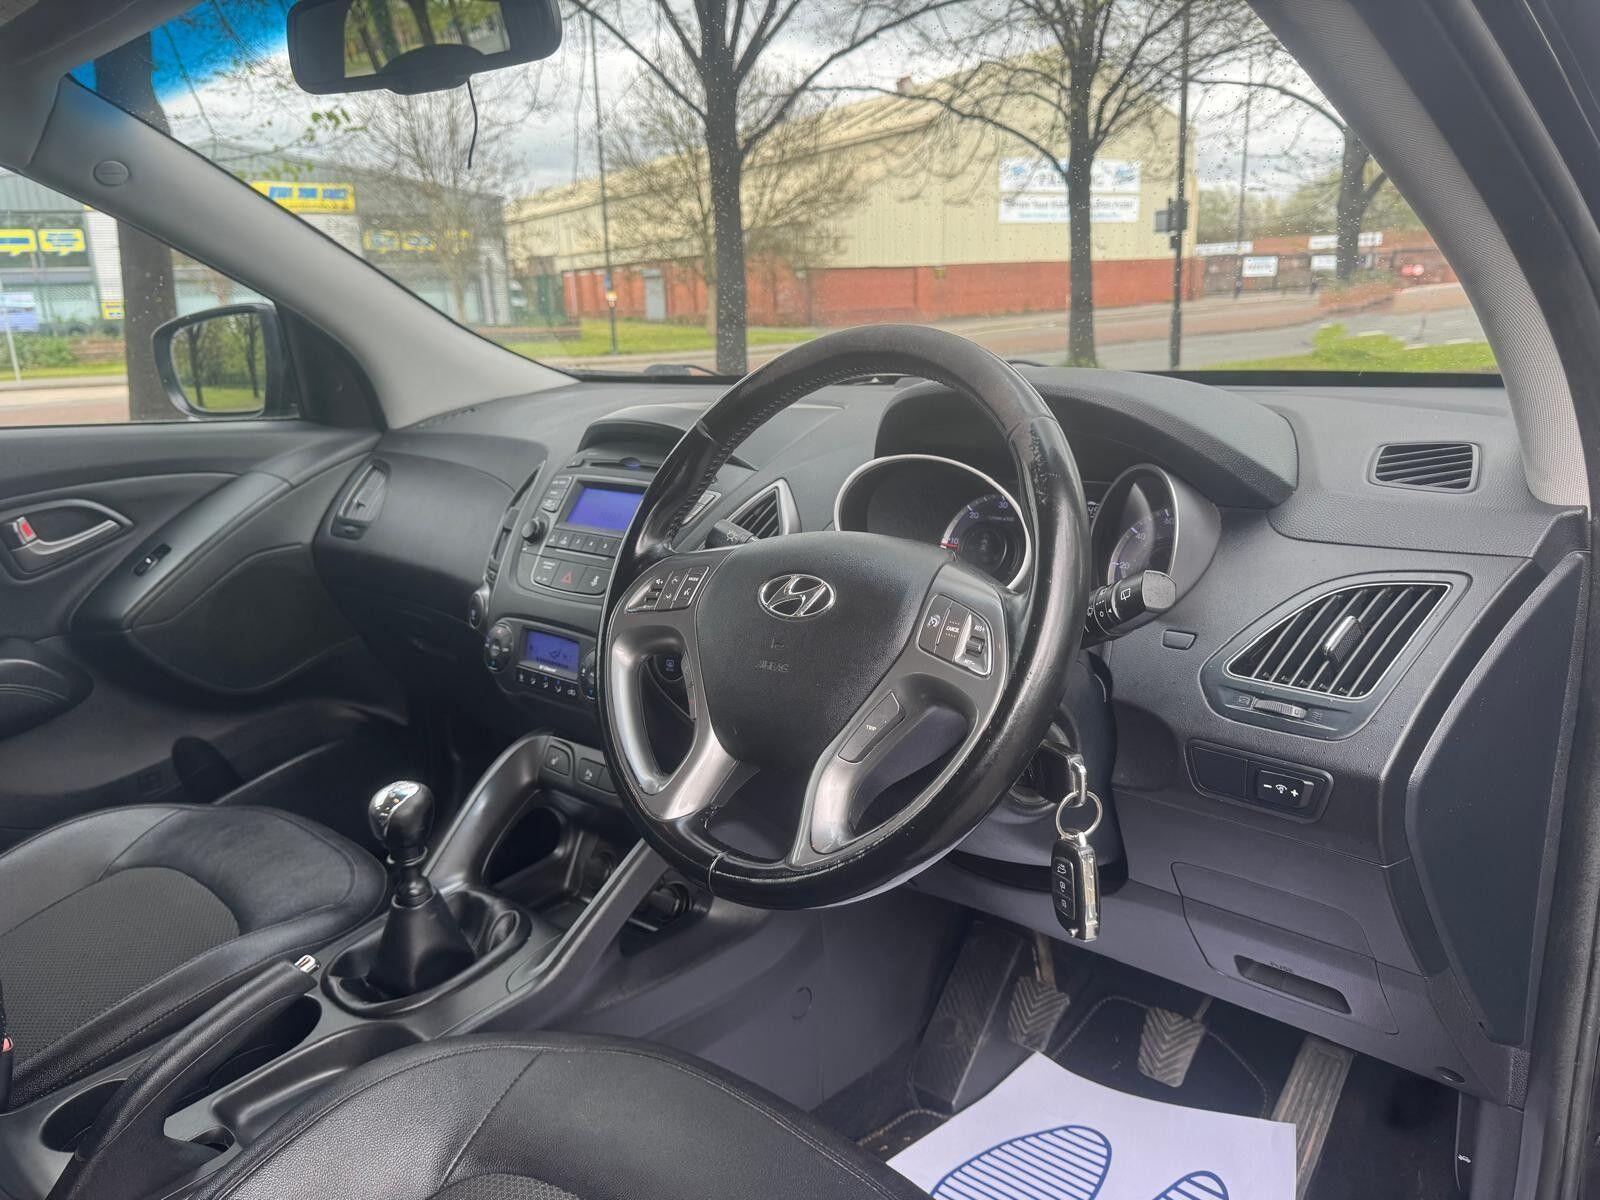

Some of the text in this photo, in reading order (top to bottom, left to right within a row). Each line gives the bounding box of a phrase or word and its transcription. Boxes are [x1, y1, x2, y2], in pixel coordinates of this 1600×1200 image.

[999, 501, 1009, 509] 30
[968, 511, 979, 520] 20
[1120, 561, 1130, 569] 20
